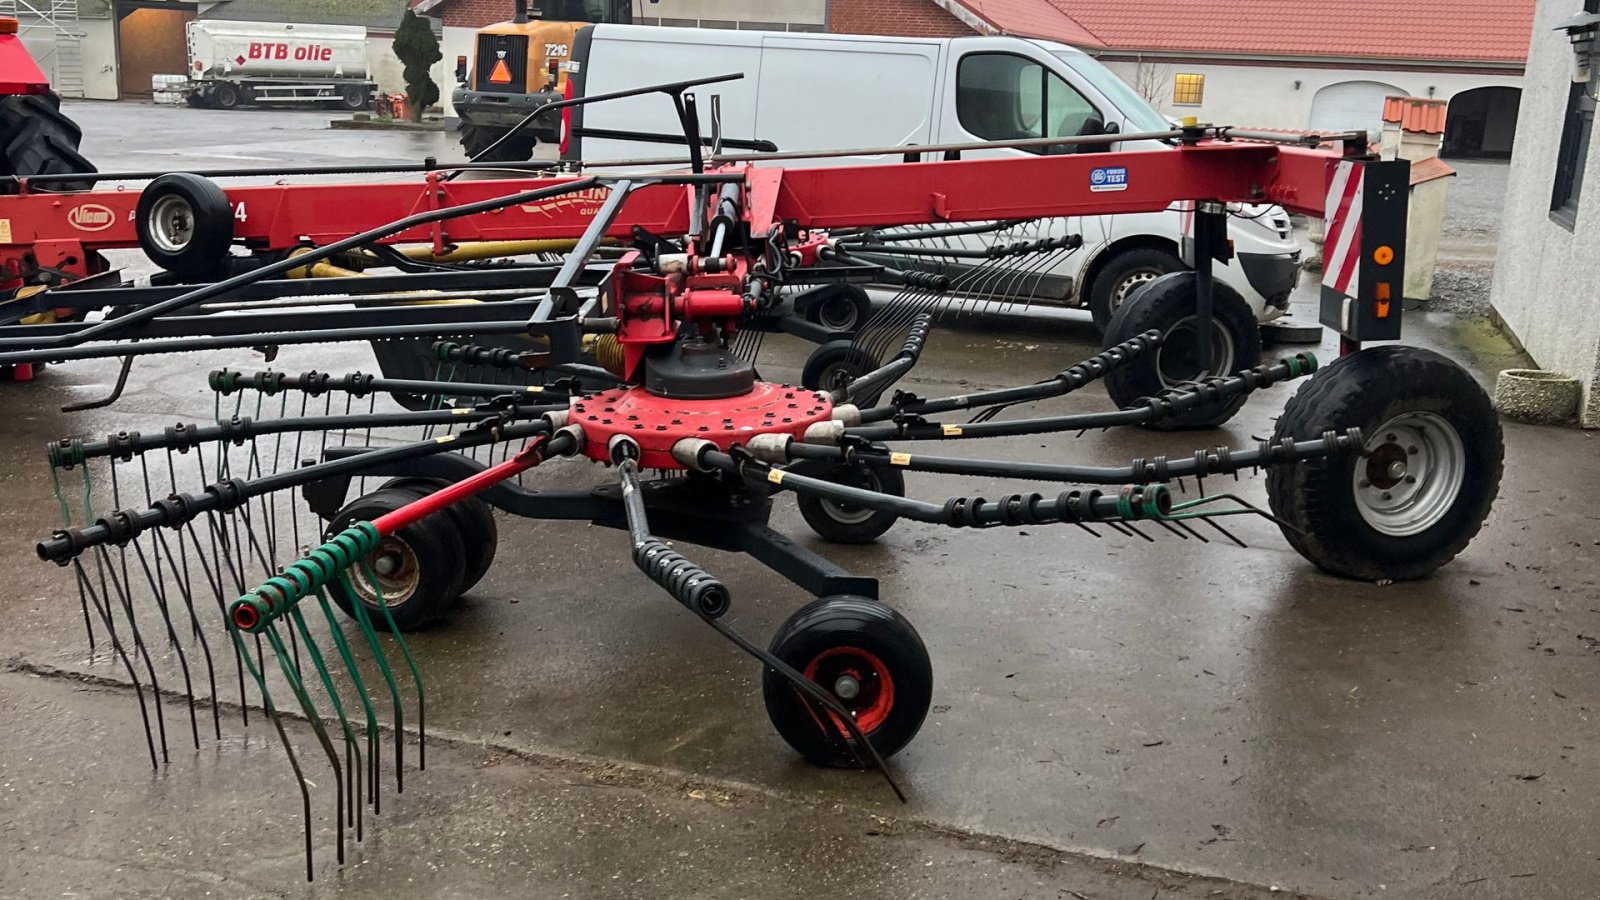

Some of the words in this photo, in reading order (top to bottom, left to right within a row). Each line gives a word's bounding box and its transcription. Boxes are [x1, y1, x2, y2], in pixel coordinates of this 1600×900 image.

[248, 42, 288, 60] BTB
[294, 44, 332, 61] olie
[544, 43, 568, 57] 721G
[1107, 174, 1126, 183] TEST
